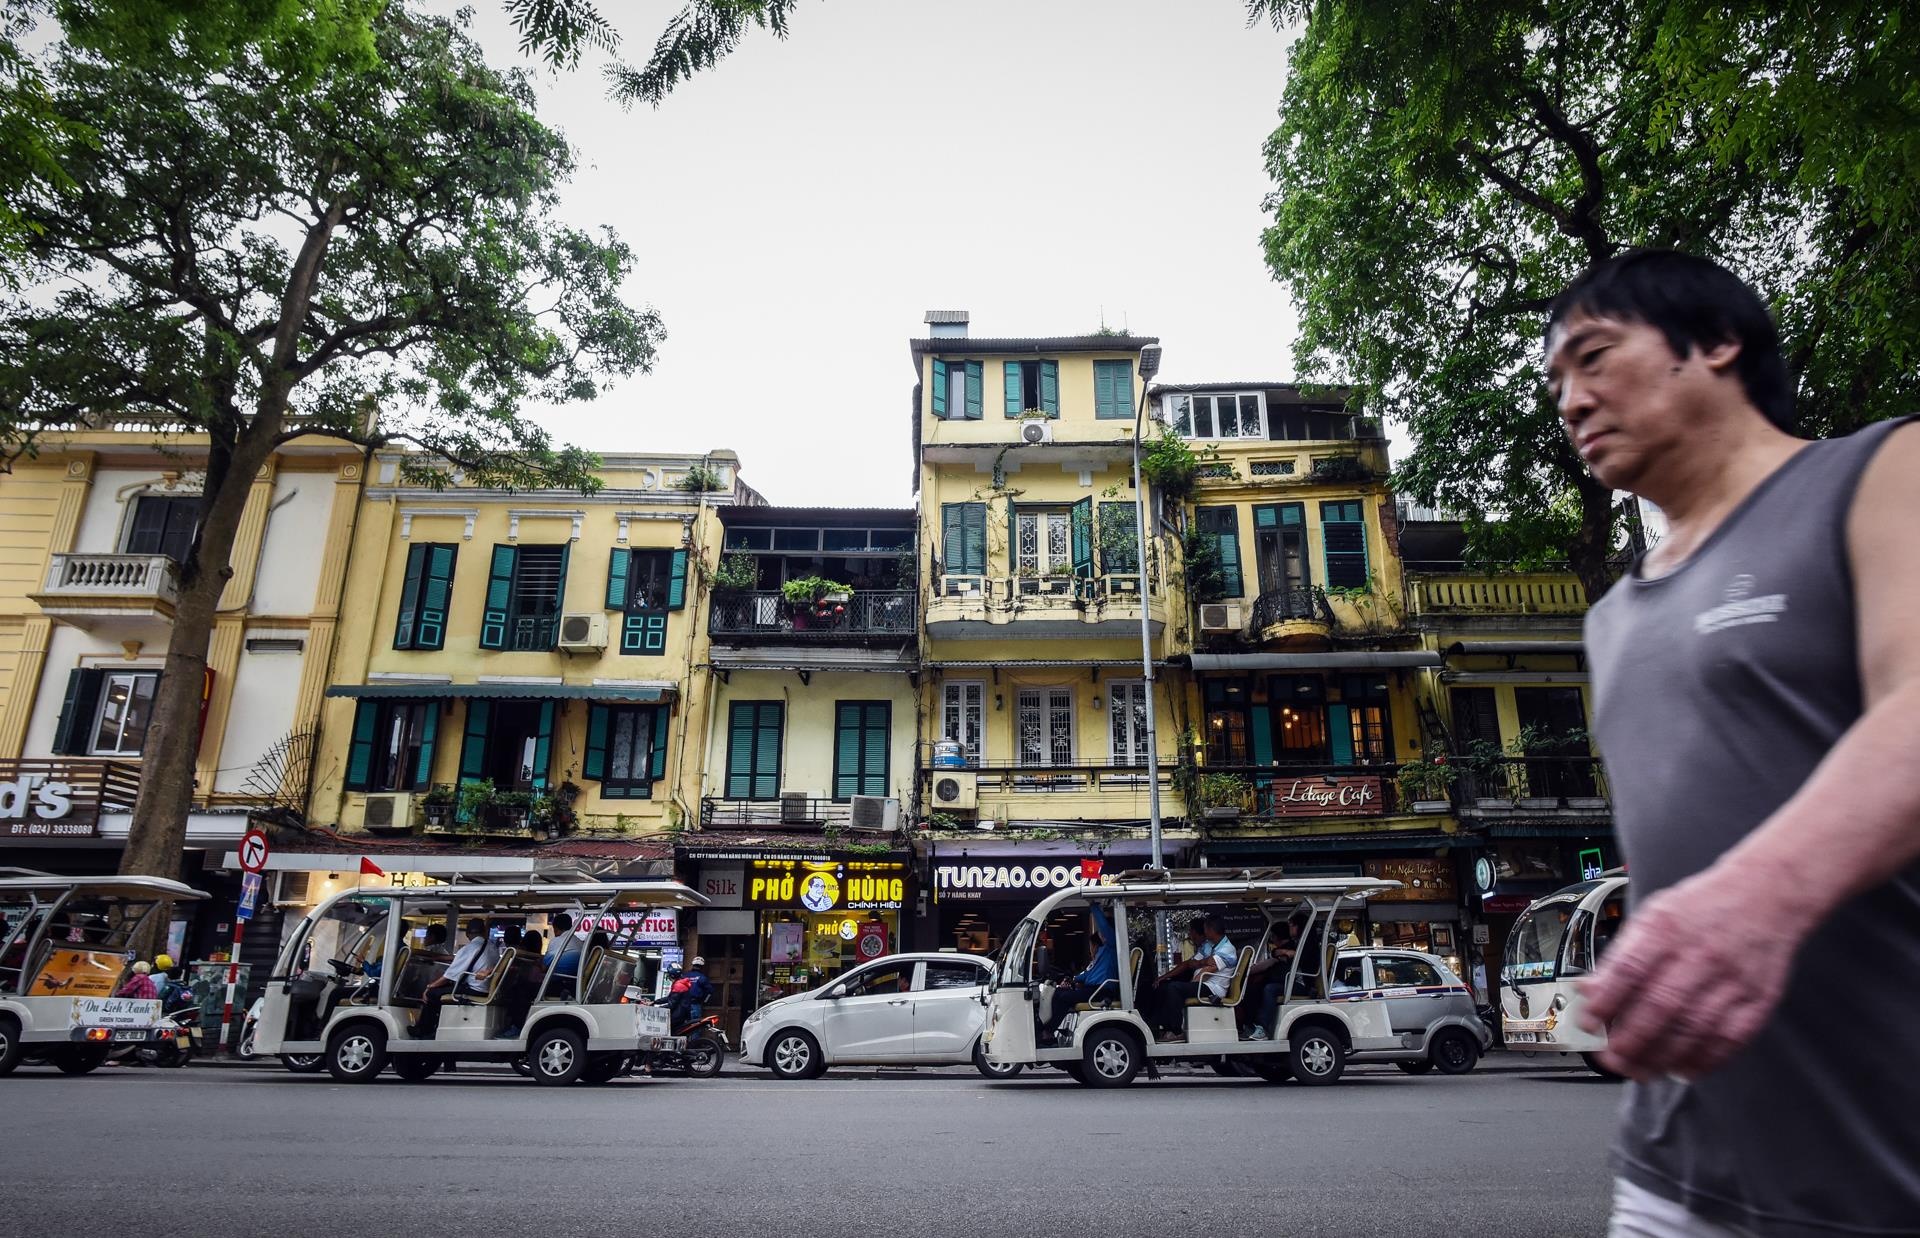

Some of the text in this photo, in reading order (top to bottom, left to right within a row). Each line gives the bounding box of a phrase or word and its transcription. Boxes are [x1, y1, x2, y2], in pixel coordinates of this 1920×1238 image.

[28, 824, 51, 835] (024)
[52, 824, 93, 834] 39338080
[706, 879, 737, 895] Silk
[751, 872, 795, 900] PHỞ
[847, 874, 904, 901] HÙNG
[847, 901, 878, 909] CHÍNH
